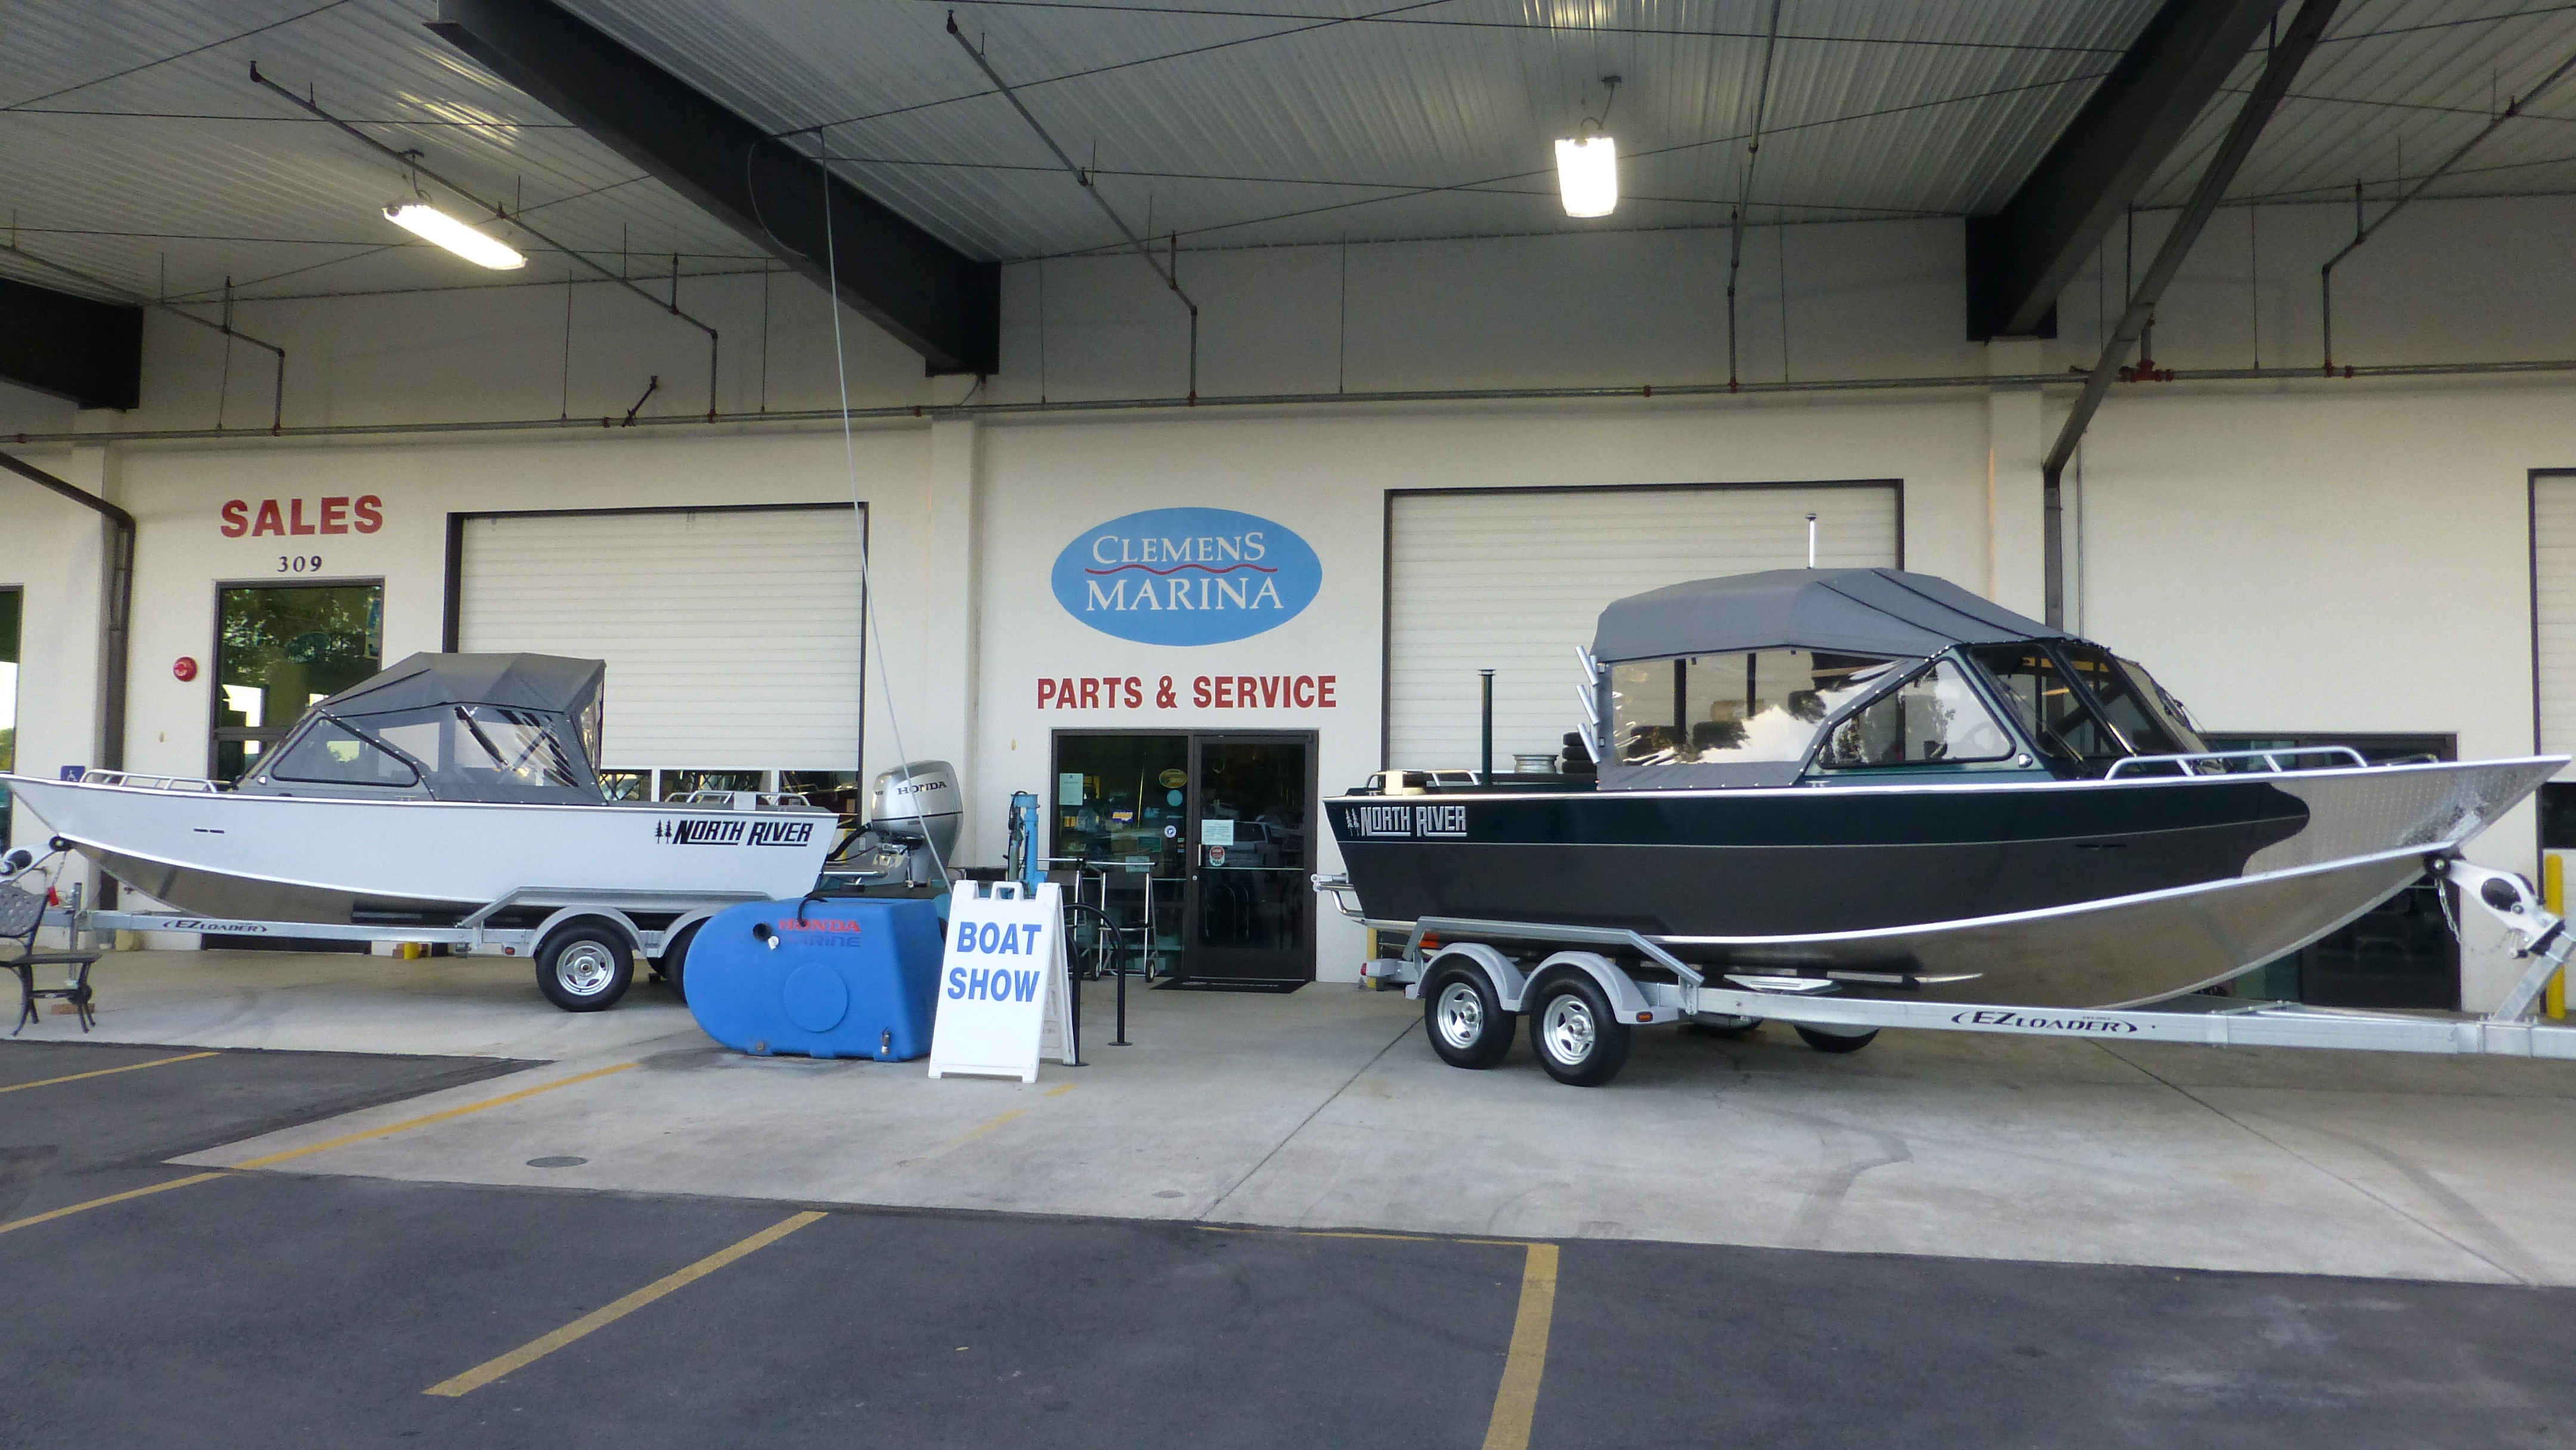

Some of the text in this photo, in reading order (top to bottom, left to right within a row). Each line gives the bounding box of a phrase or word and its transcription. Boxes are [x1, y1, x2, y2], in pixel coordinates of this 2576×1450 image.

[220, 494, 383, 538] SALES
[277, 556, 323, 572] 309
[1092, 532, 1266, 564] CLEMENS
[1086, 576, 1284, 611] MARINA
[1037, 675, 1337, 709] PARTS & SERVICE
[897, 781, 948, 795] HONDA
[672, 819, 814, 847] NORTH RIVER
[1360, 805, 1467, 837] NORTH RIVER
[779, 918, 862, 932] HONDA
[779, 933, 861, 947] ARINE
[956, 921, 1042, 955] BOAT
[948, 966, 1041, 1002] SHOW
